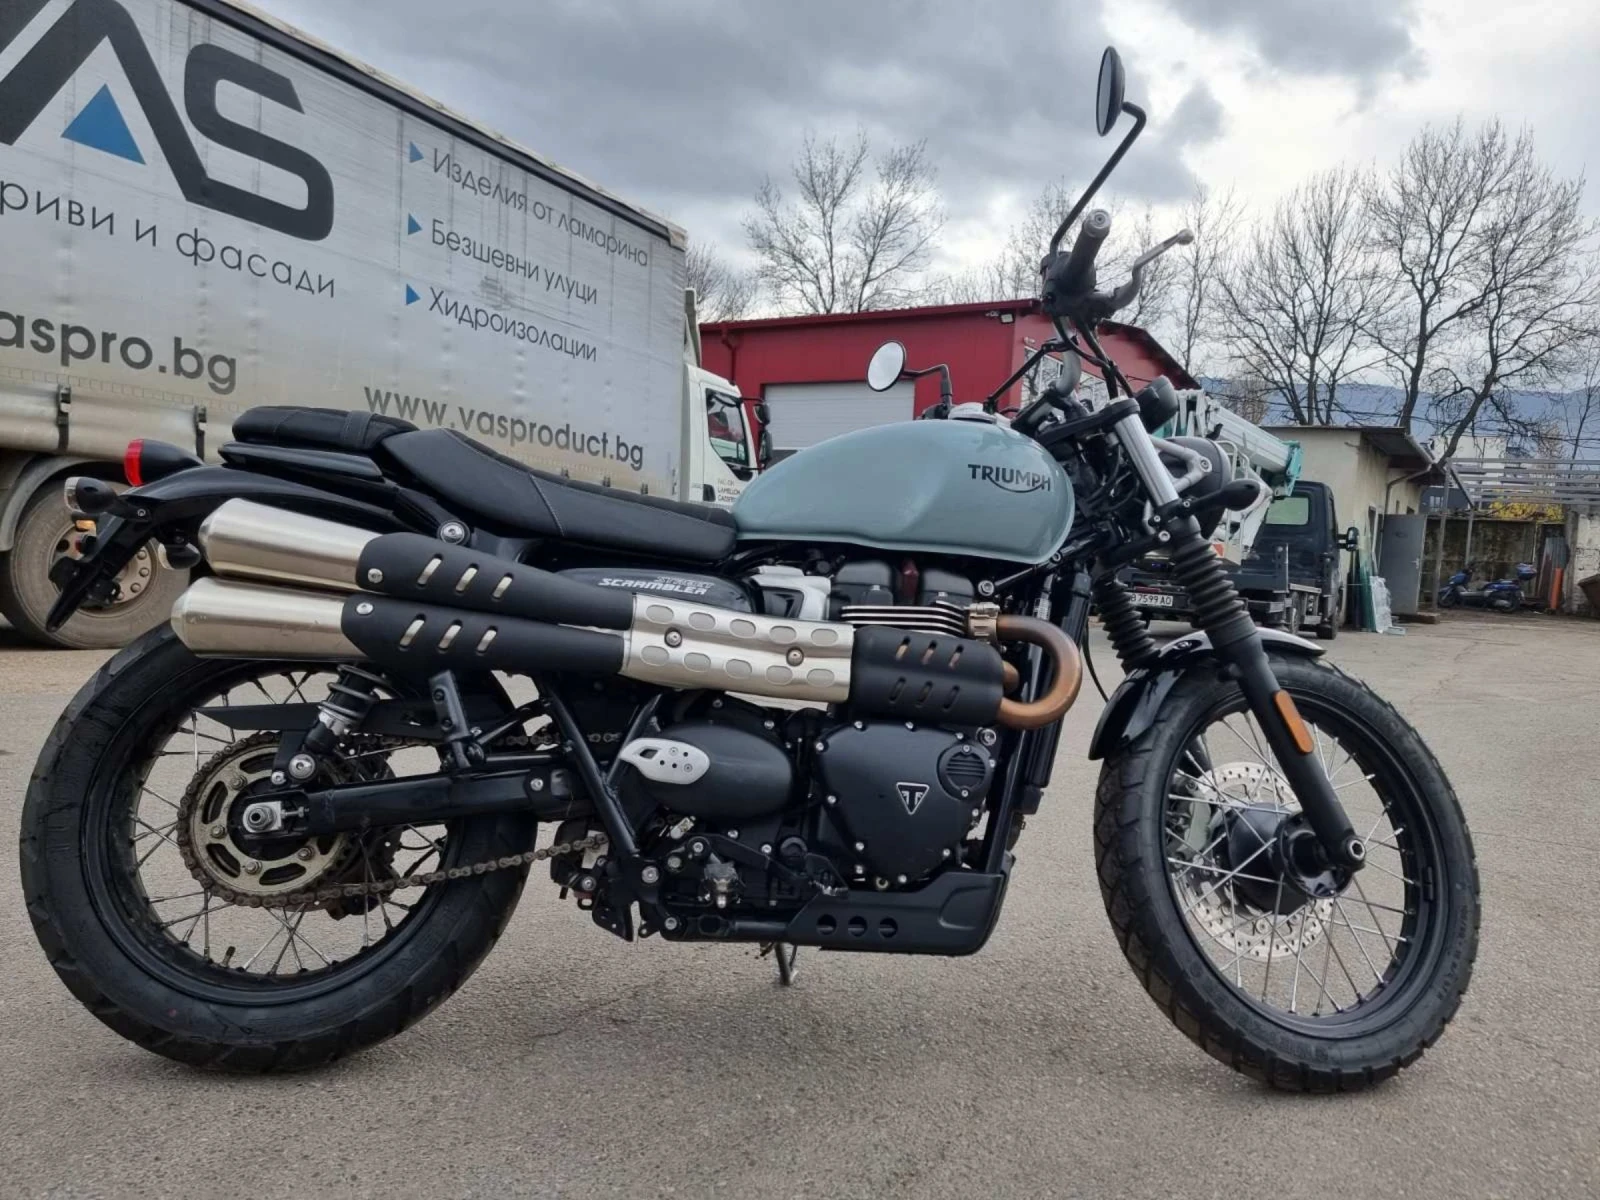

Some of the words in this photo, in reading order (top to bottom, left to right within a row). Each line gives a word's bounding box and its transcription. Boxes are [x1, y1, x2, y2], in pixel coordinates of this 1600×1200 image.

[434, 147, 528, 213] Изделия
[533, 201, 553, 220] от
[558, 214, 648, 267] ламарина
[136, 219, 156, 247] и
[176, 227, 334, 298] фасади
[432, 219, 539, 282] Безшевни
[545, 268, 597, 305] улуци
[429, 287, 597, 362] Хидроизолации
[364, 386, 644, 471] www.vasproduct.bg
[967, 463, 1051, 493] TRIUMPH
[597, 577, 707, 595] SCRAMBLER
